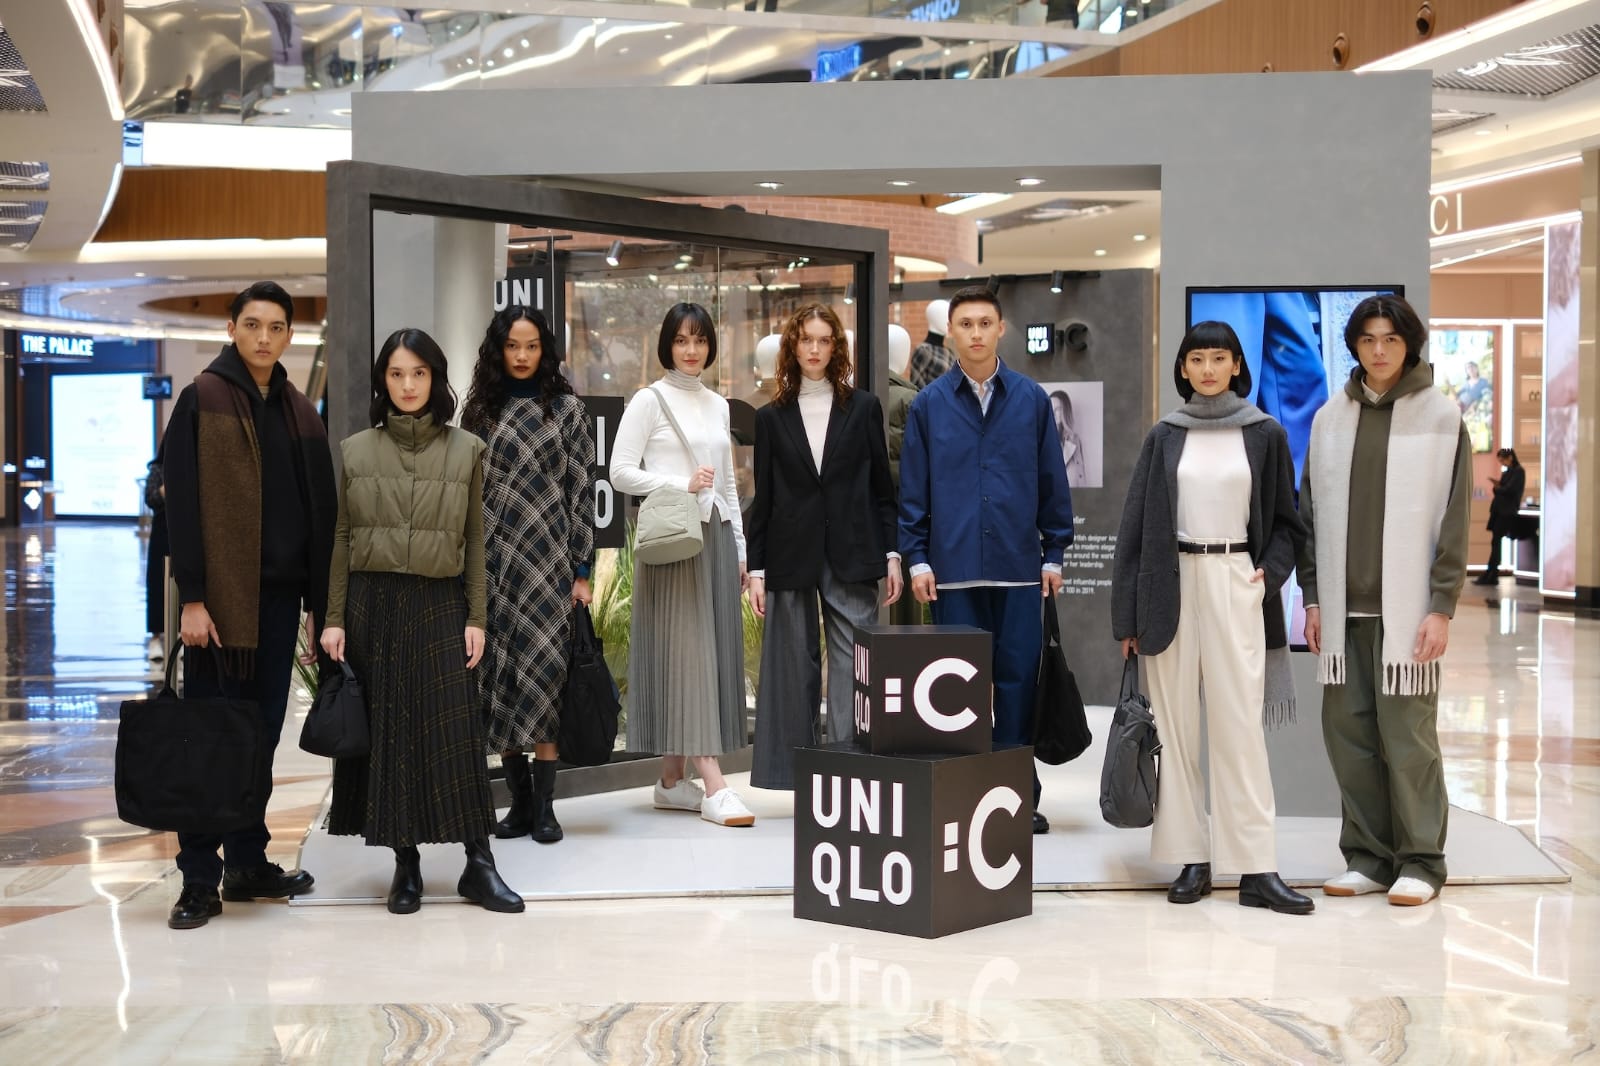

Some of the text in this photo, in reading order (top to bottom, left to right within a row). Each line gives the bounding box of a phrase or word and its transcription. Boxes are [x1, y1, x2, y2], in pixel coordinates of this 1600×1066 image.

[494, 278, 543, 312] UNI
[22, 334, 94, 357] THE PALACE
[1027, 326, 1047, 339] UNI
[1027, 339, 1049, 354] QLO
[1091, 551, 1099, 559] the
[855, 643, 869, 687] UNI
[854, 689, 871, 736] QLO
[812, 773, 904, 838] UNI
[811, 841, 913, 908] QLO
